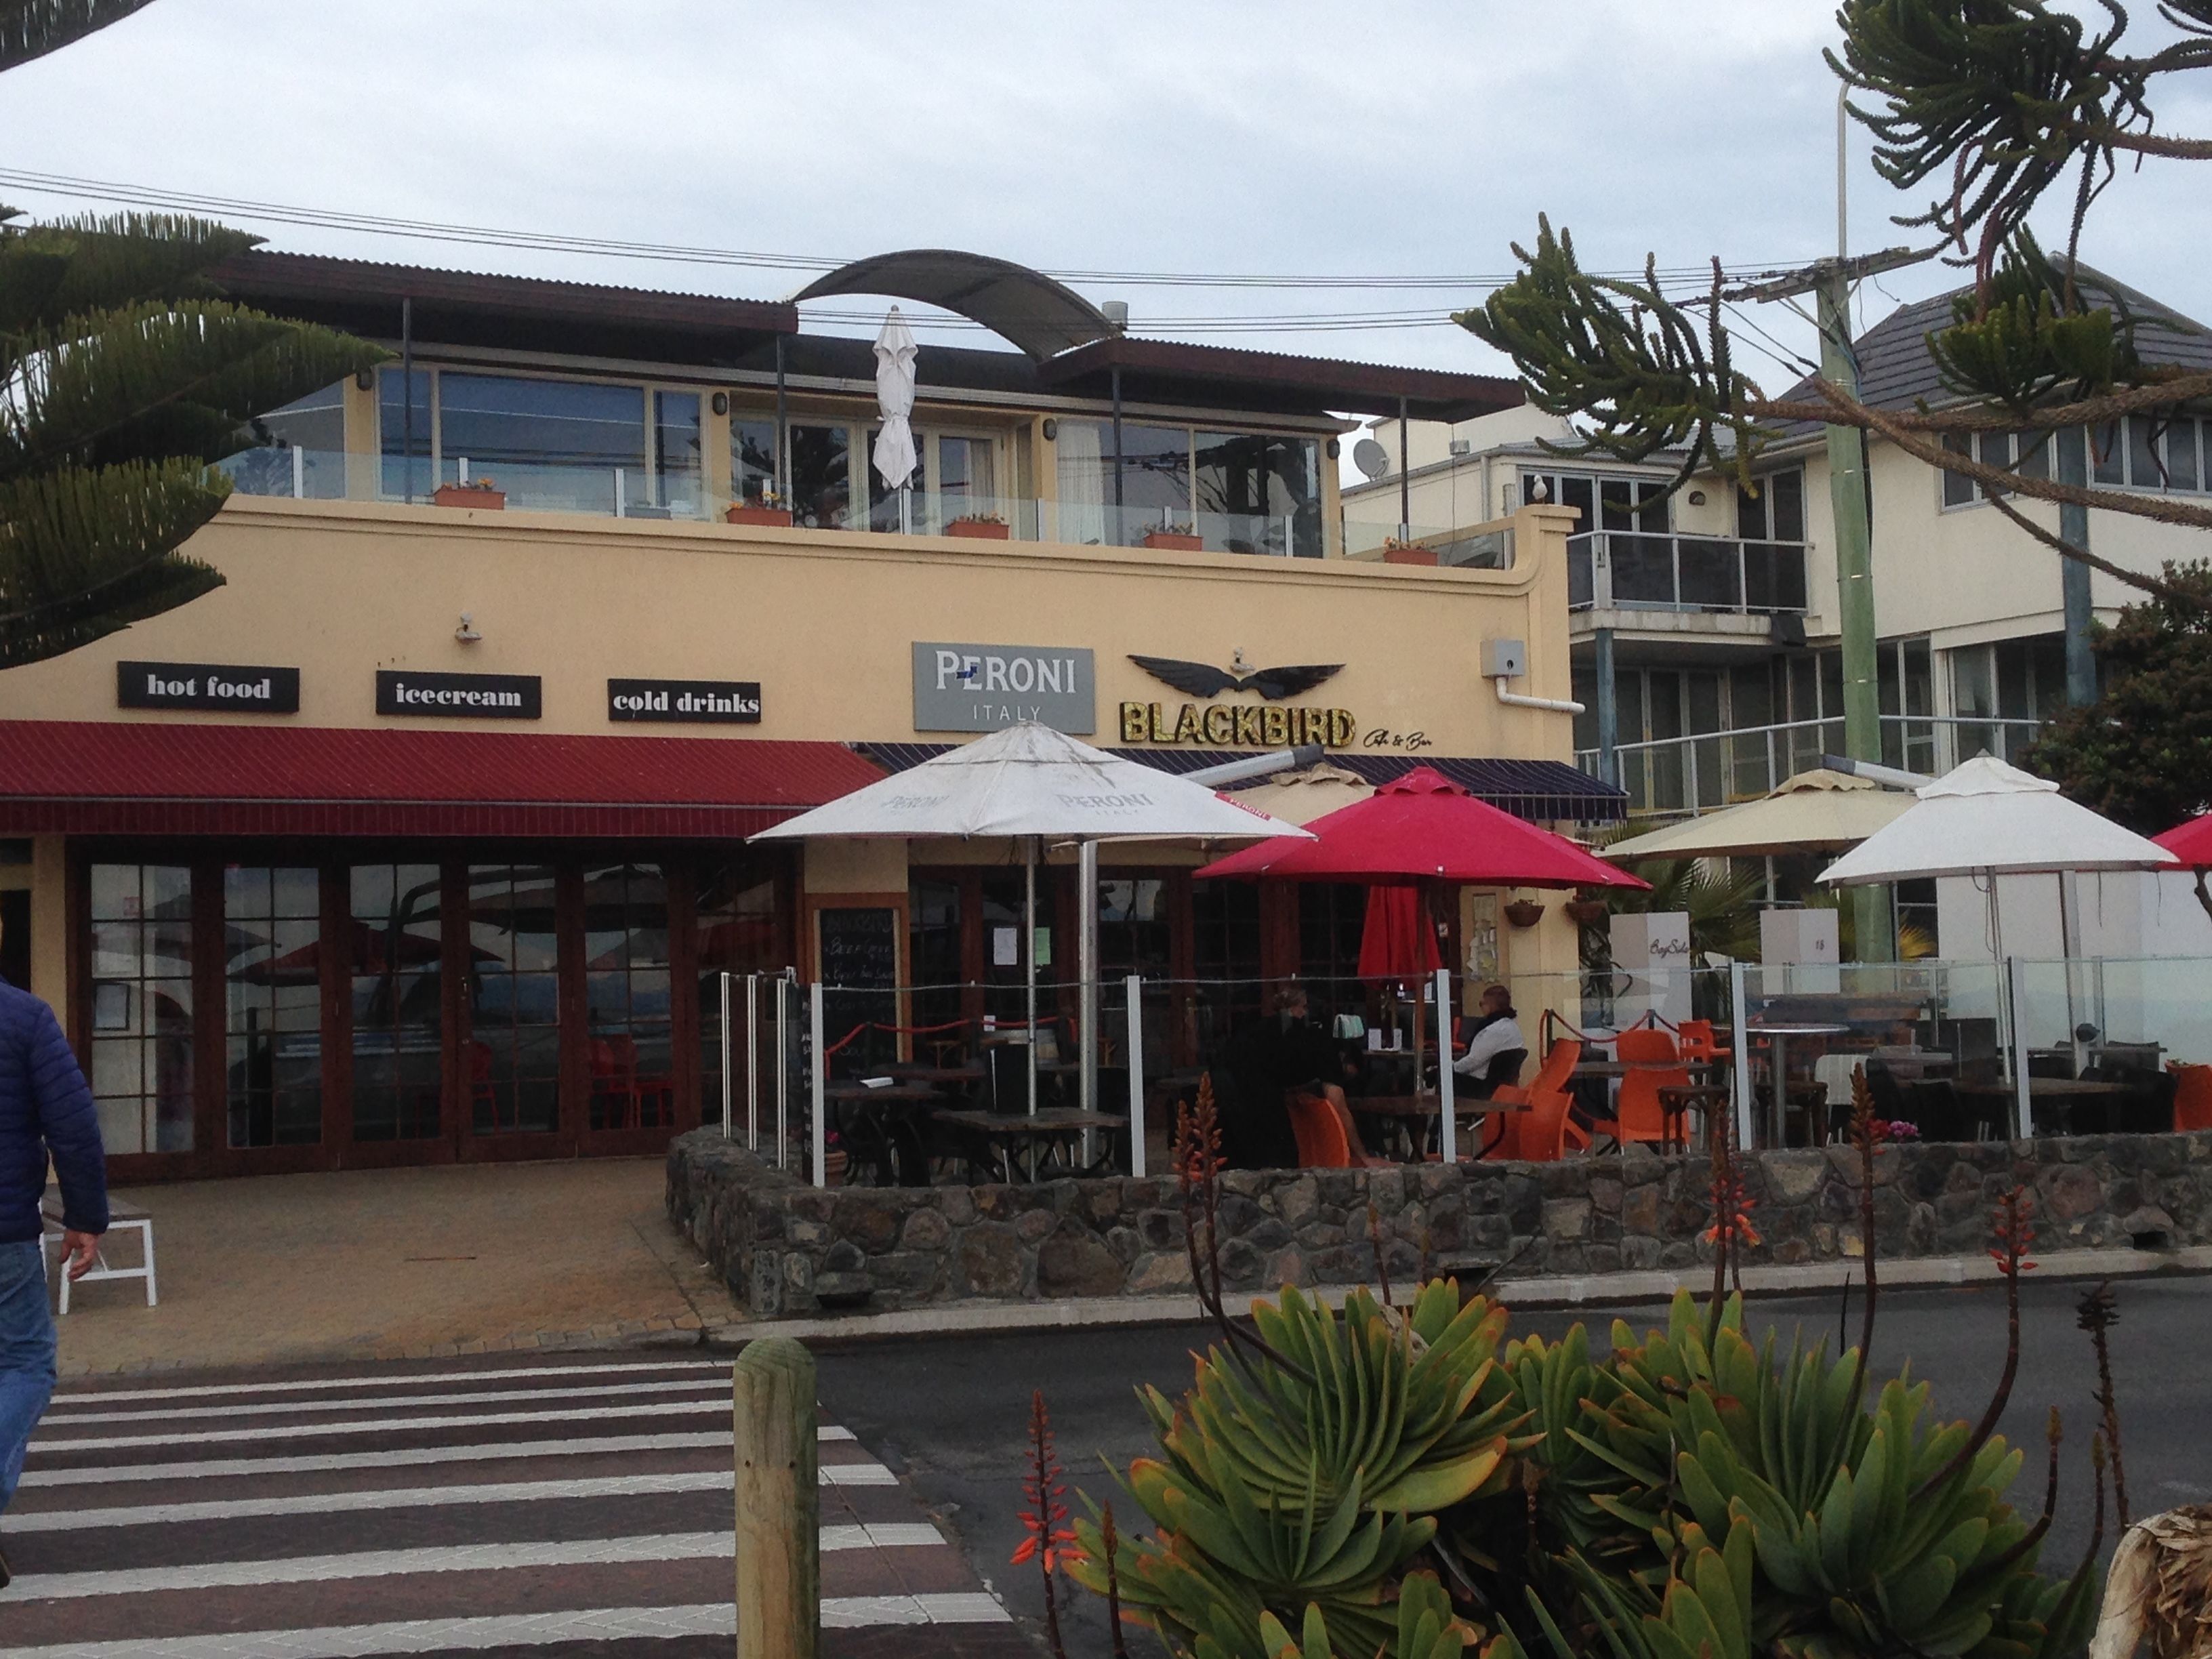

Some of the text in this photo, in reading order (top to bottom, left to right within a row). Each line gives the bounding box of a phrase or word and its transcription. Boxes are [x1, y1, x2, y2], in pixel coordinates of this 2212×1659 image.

[935, 651, 1076, 693] PERONI
[147, 674, 270, 699] hot food
[395, 682, 521, 706] icecream
[613, 691, 759, 714] cold drinks
[973, 705, 1040, 720] ITALY
[1120, 701, 1356, 747] BLACKBIRD
[1392, 735, 1404, 746] &
[1053, 793, 1155, 808] PERONI
